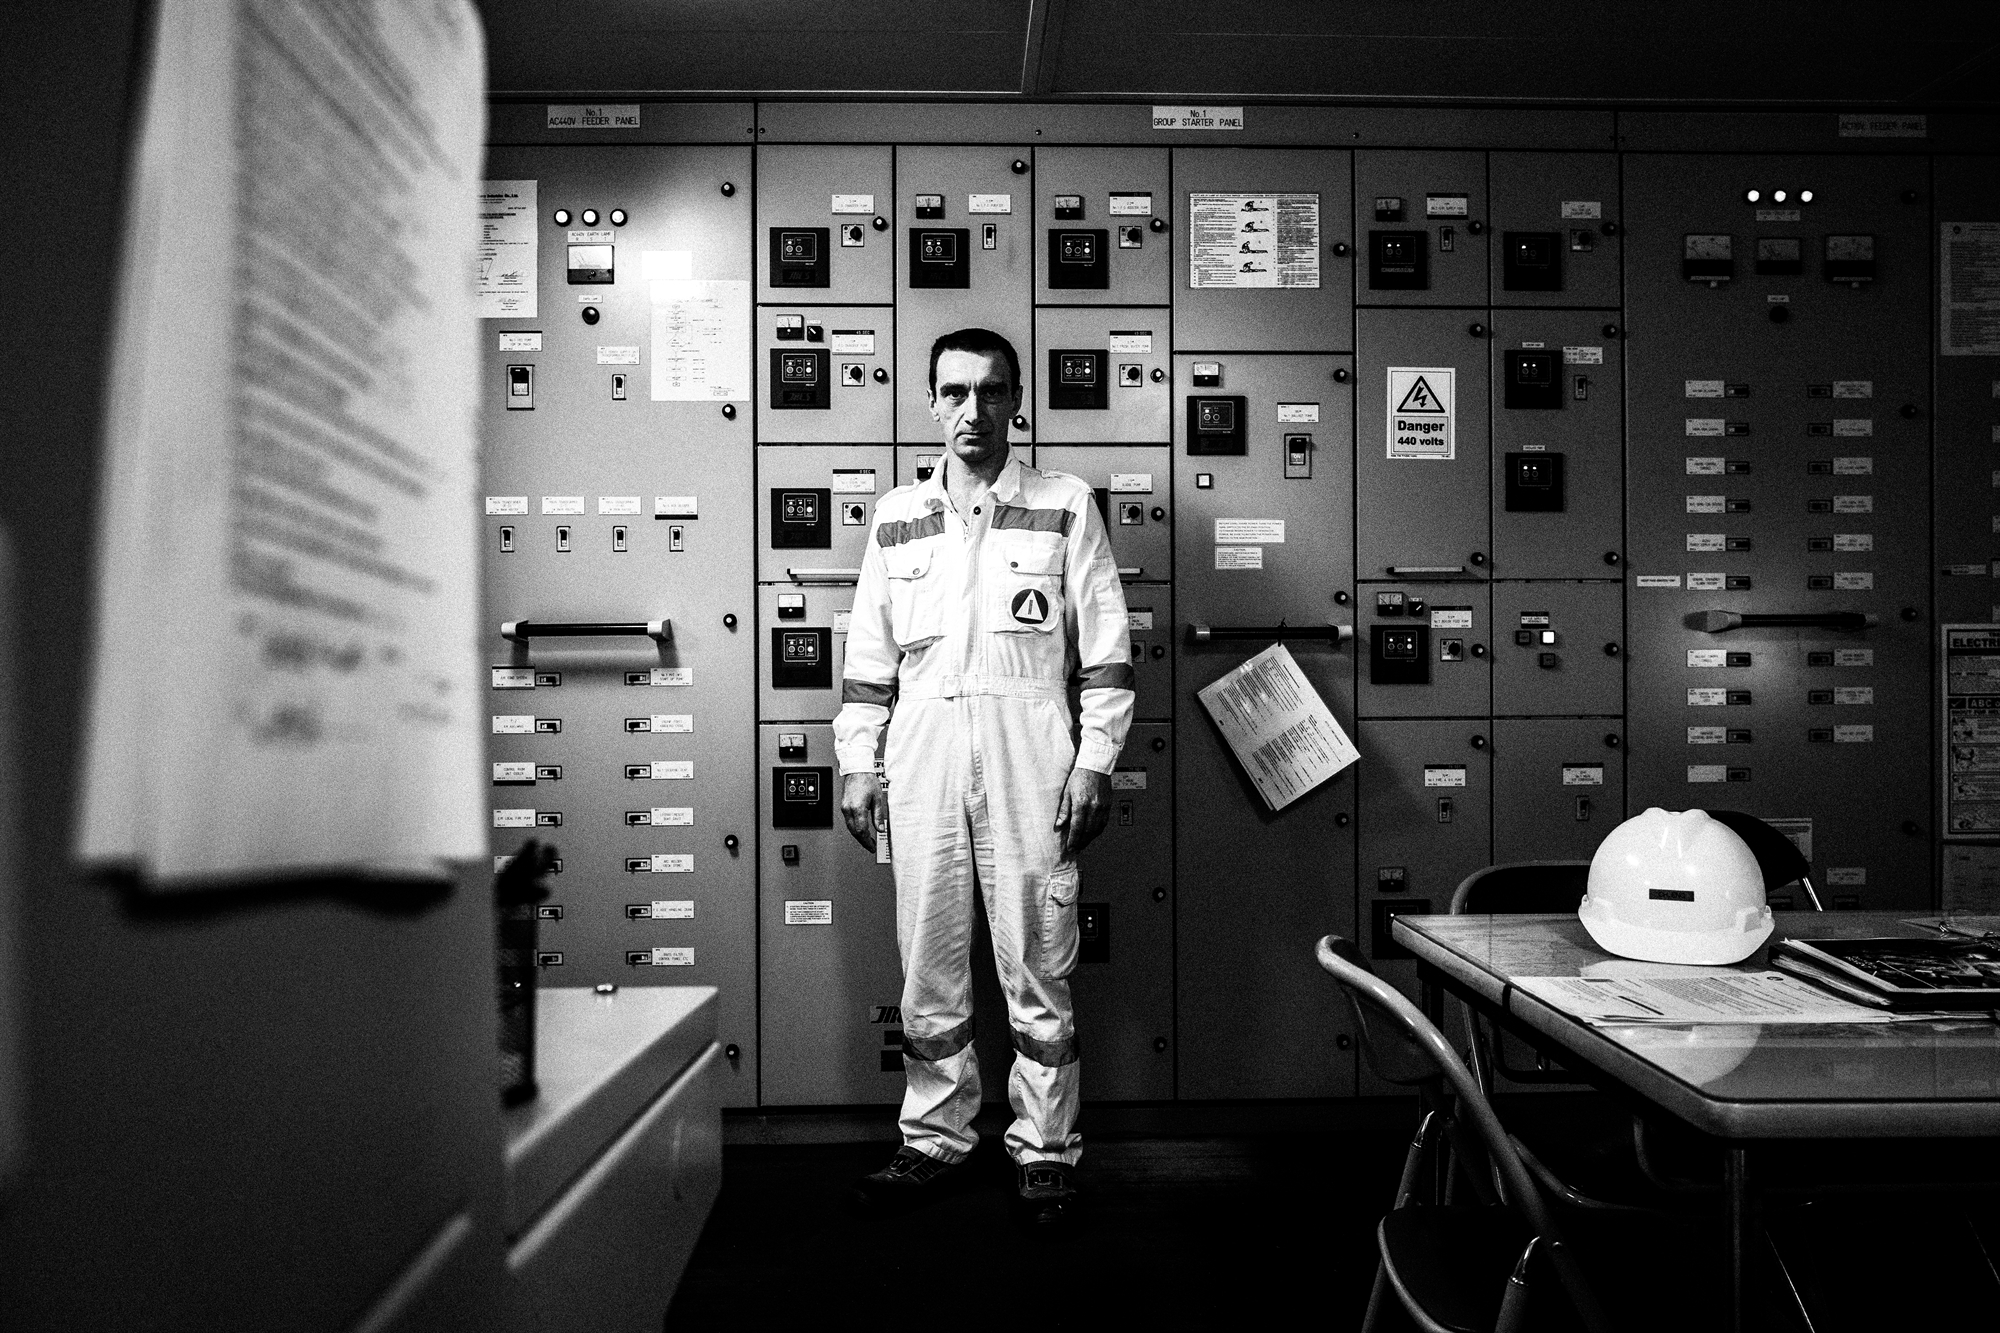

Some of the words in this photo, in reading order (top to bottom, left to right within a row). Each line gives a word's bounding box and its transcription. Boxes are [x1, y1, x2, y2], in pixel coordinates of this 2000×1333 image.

[586, 108, 602, 116] No.1
[1190, 110, 1206, 118] No.1
[548, 116, 576, 126] AC440V
[582, 116, 610, 126] FEEDER
[615, 116, 638, 126] PANEL
[1153, 118, 1177, 127] GROUP
[1182, 118, 1214, 127] STARTER
[1220, 118, 1242, 127] PANEL
[1398, 420, 1444, 434] Danger
[1398, 436, 1416, 445] 440
[1420, 437, 1444, 446] volts
